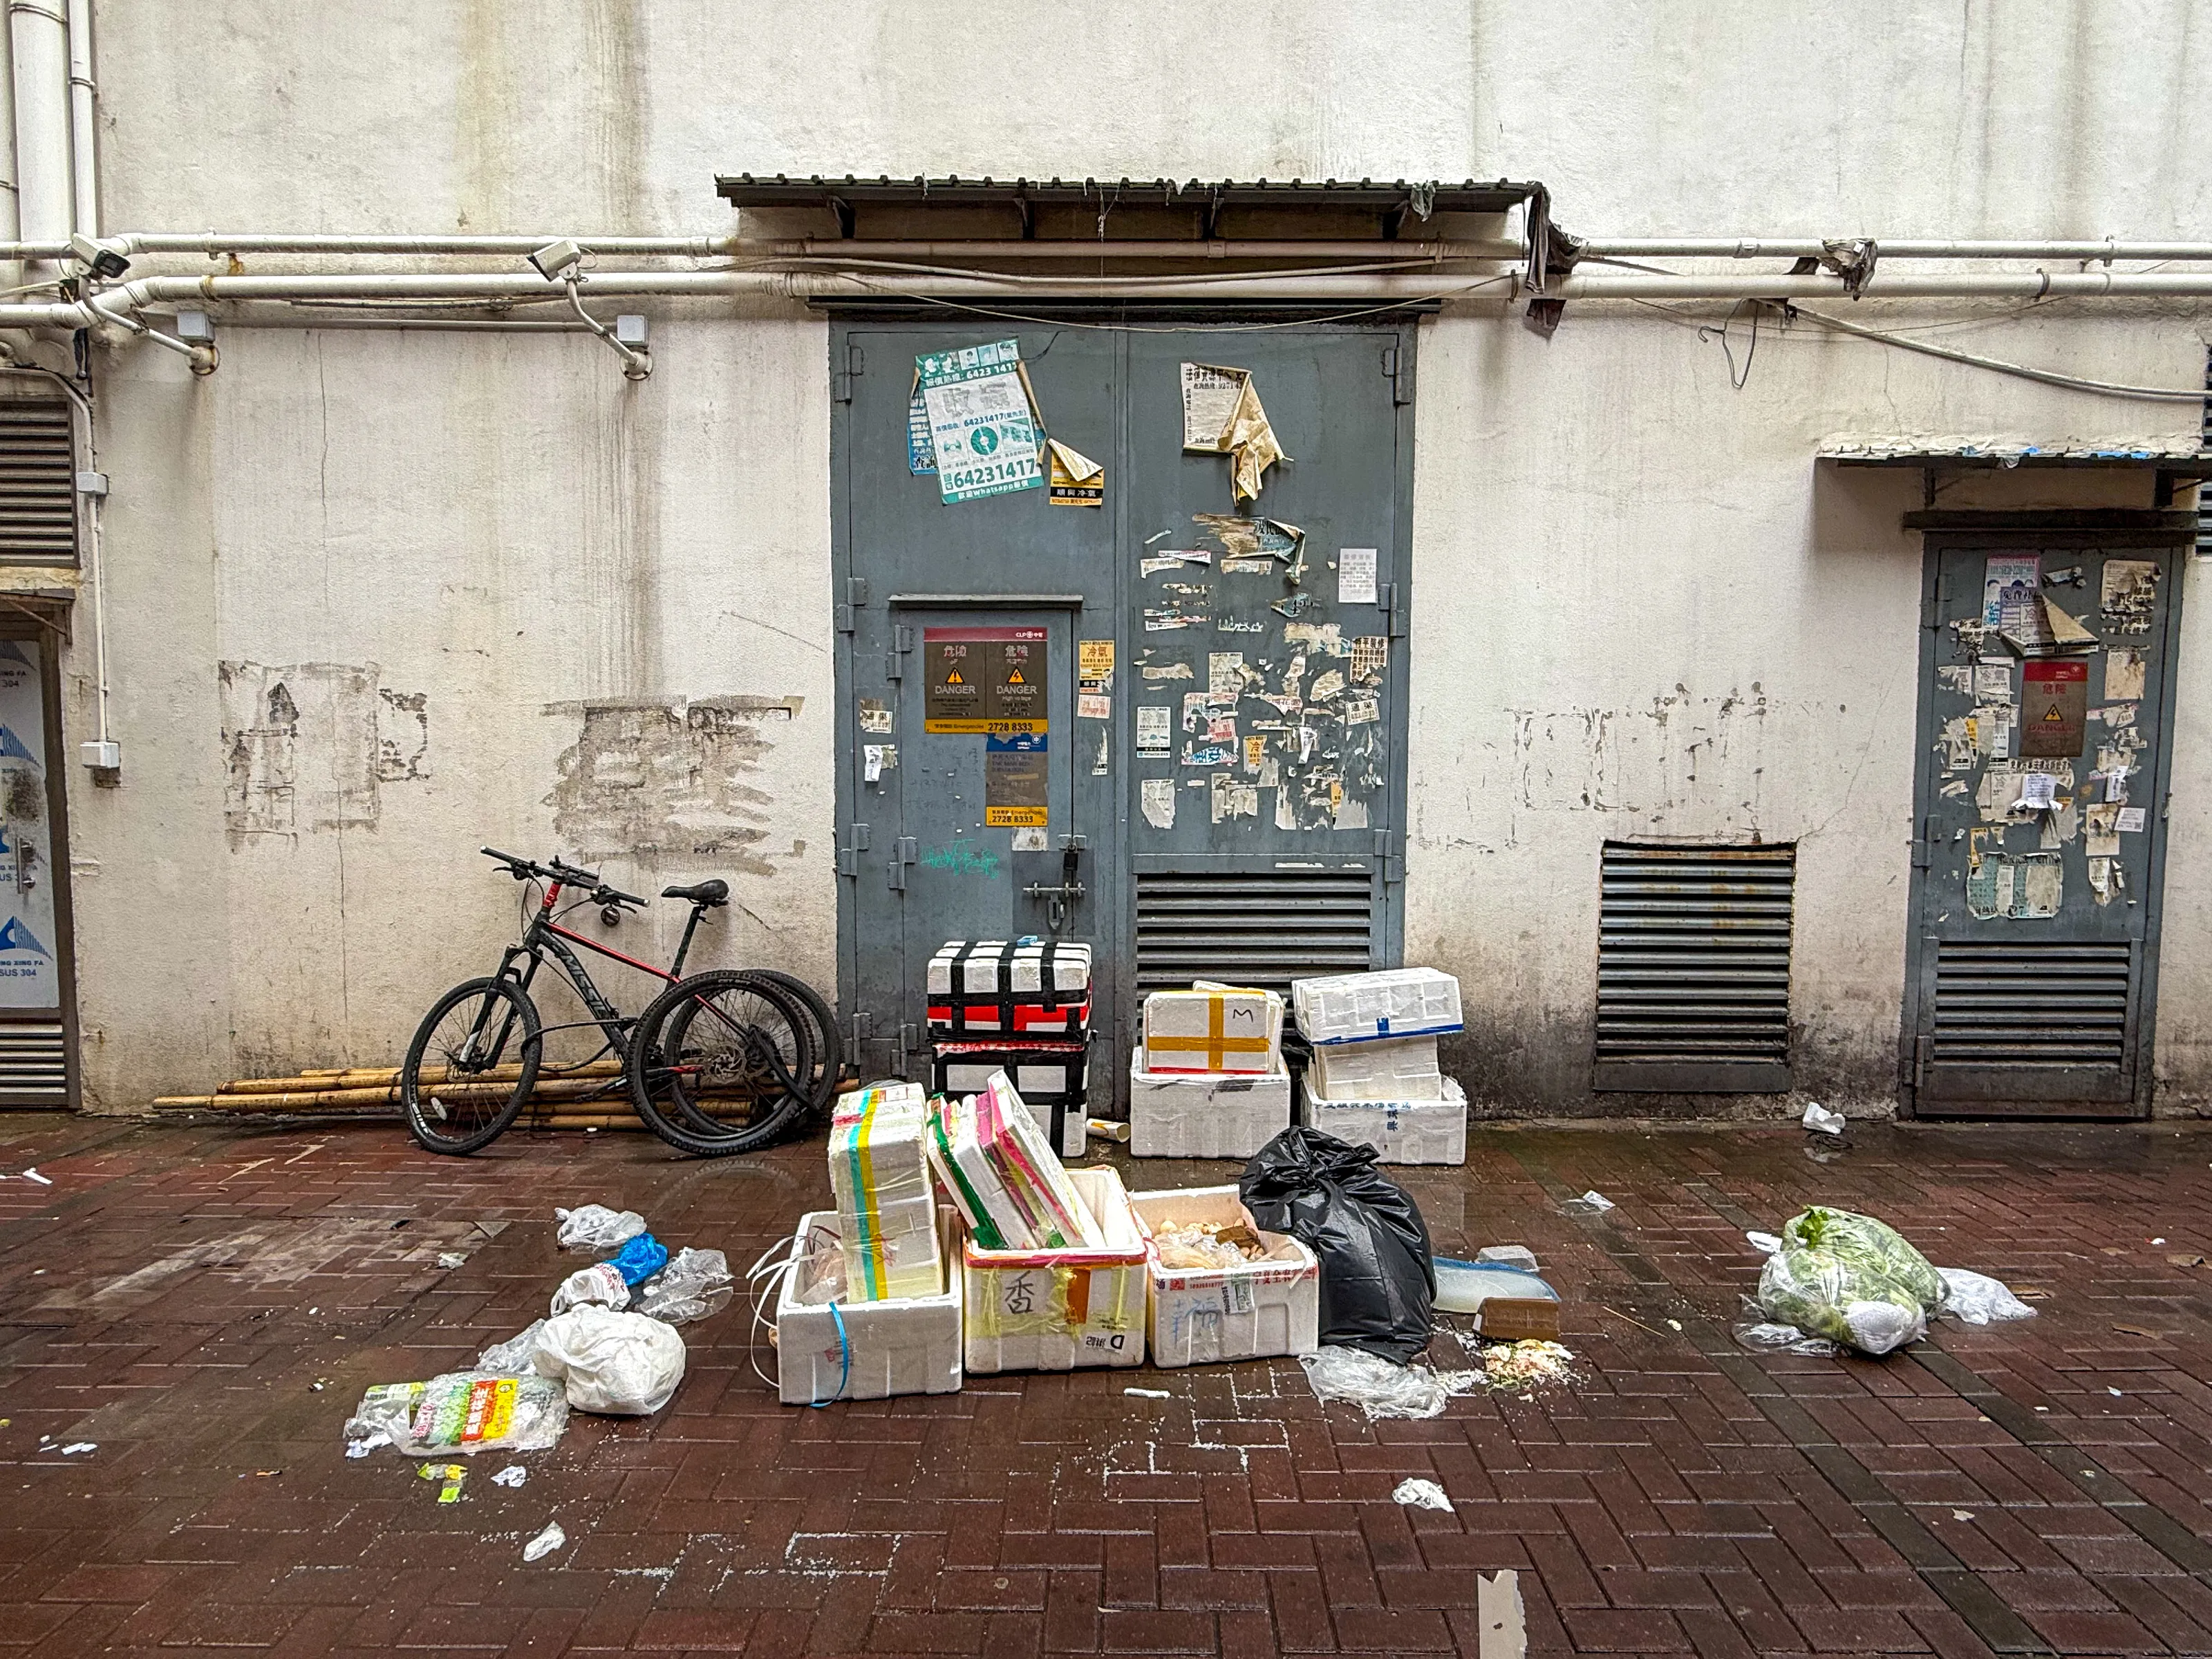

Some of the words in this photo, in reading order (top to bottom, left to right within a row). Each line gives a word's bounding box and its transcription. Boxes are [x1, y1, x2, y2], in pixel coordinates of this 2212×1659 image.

[966, 367, 991, 379] 6423
[954, 458, 1036, 488] 64231417
[1005, 645, 1029, 657] 危險
[935, 686, 976, 694] DANGER
[996, 686, 1038, 694] DANGER
[988, 722, 1009, 731] 2728
[1011, 722, 1033, 731] 8333
[21, 968, 37, 977] 304
[560, 954, 615, 1026] MISSIL
[1004, 1270, 1035, 1314] 香
